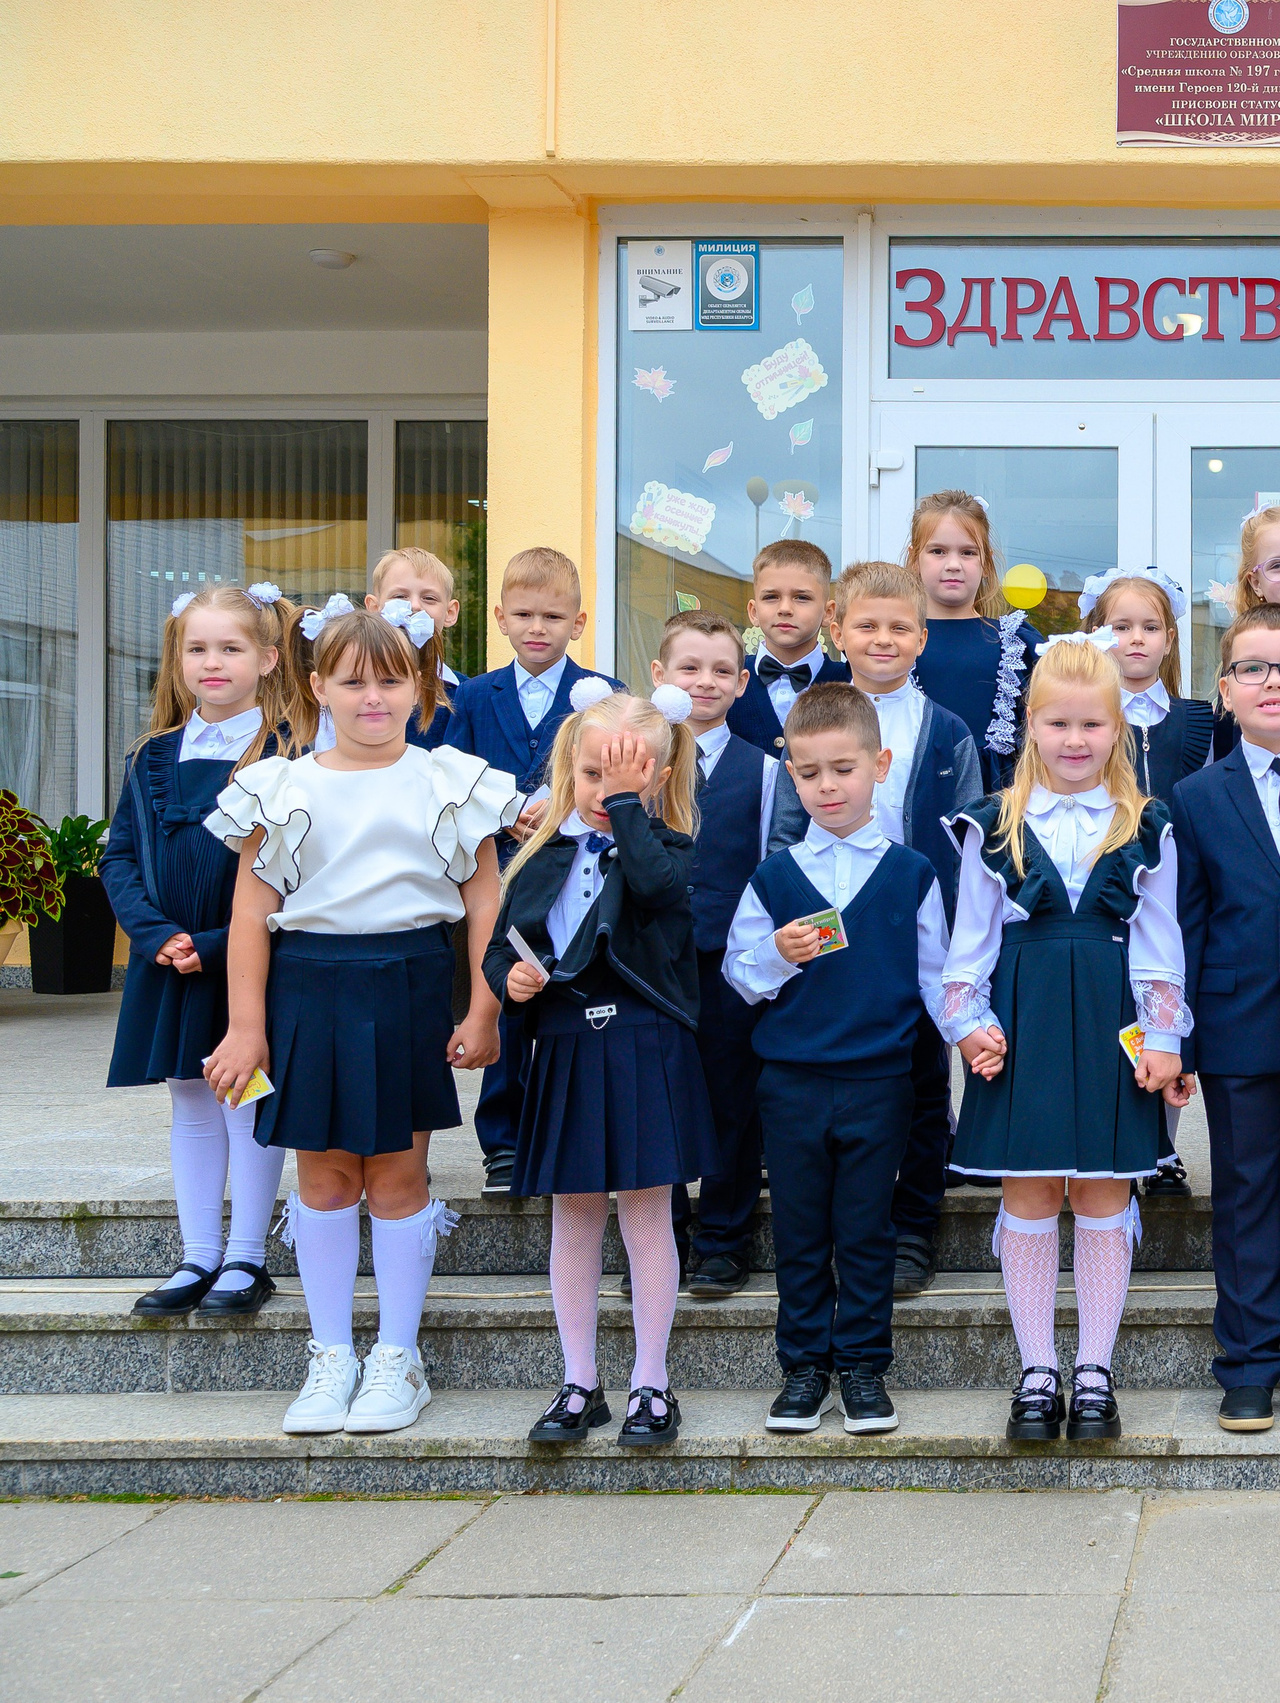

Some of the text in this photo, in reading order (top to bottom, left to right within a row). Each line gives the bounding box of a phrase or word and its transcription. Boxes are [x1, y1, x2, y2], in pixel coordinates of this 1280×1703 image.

[1146, 50, 1227, 60] УЧРЕЖДЕНИЮ
[1121, 65, 1182, 78] «Средняя
[1185, 67, 1226, 77] школа
[1229, 67, 1243, 77] №
[1247, 65, 1270, 77] 197
[1134, 84, 1175, 93] имени
[1179, 83, 1223, 93] Героев
[1227, 83, 1260, 93] 120-й
[1171, 100, 1237, 109] ПРИСВОЕН
[1155, 114, 1235, 127] «ШКОЛА
[698, 244, 756, 253] МИЛИЦИЯ
[763, 352, 789, 371] Буду
[666, 493, 709, 516] уже жду
[664, 505, 703, 524] осенние
